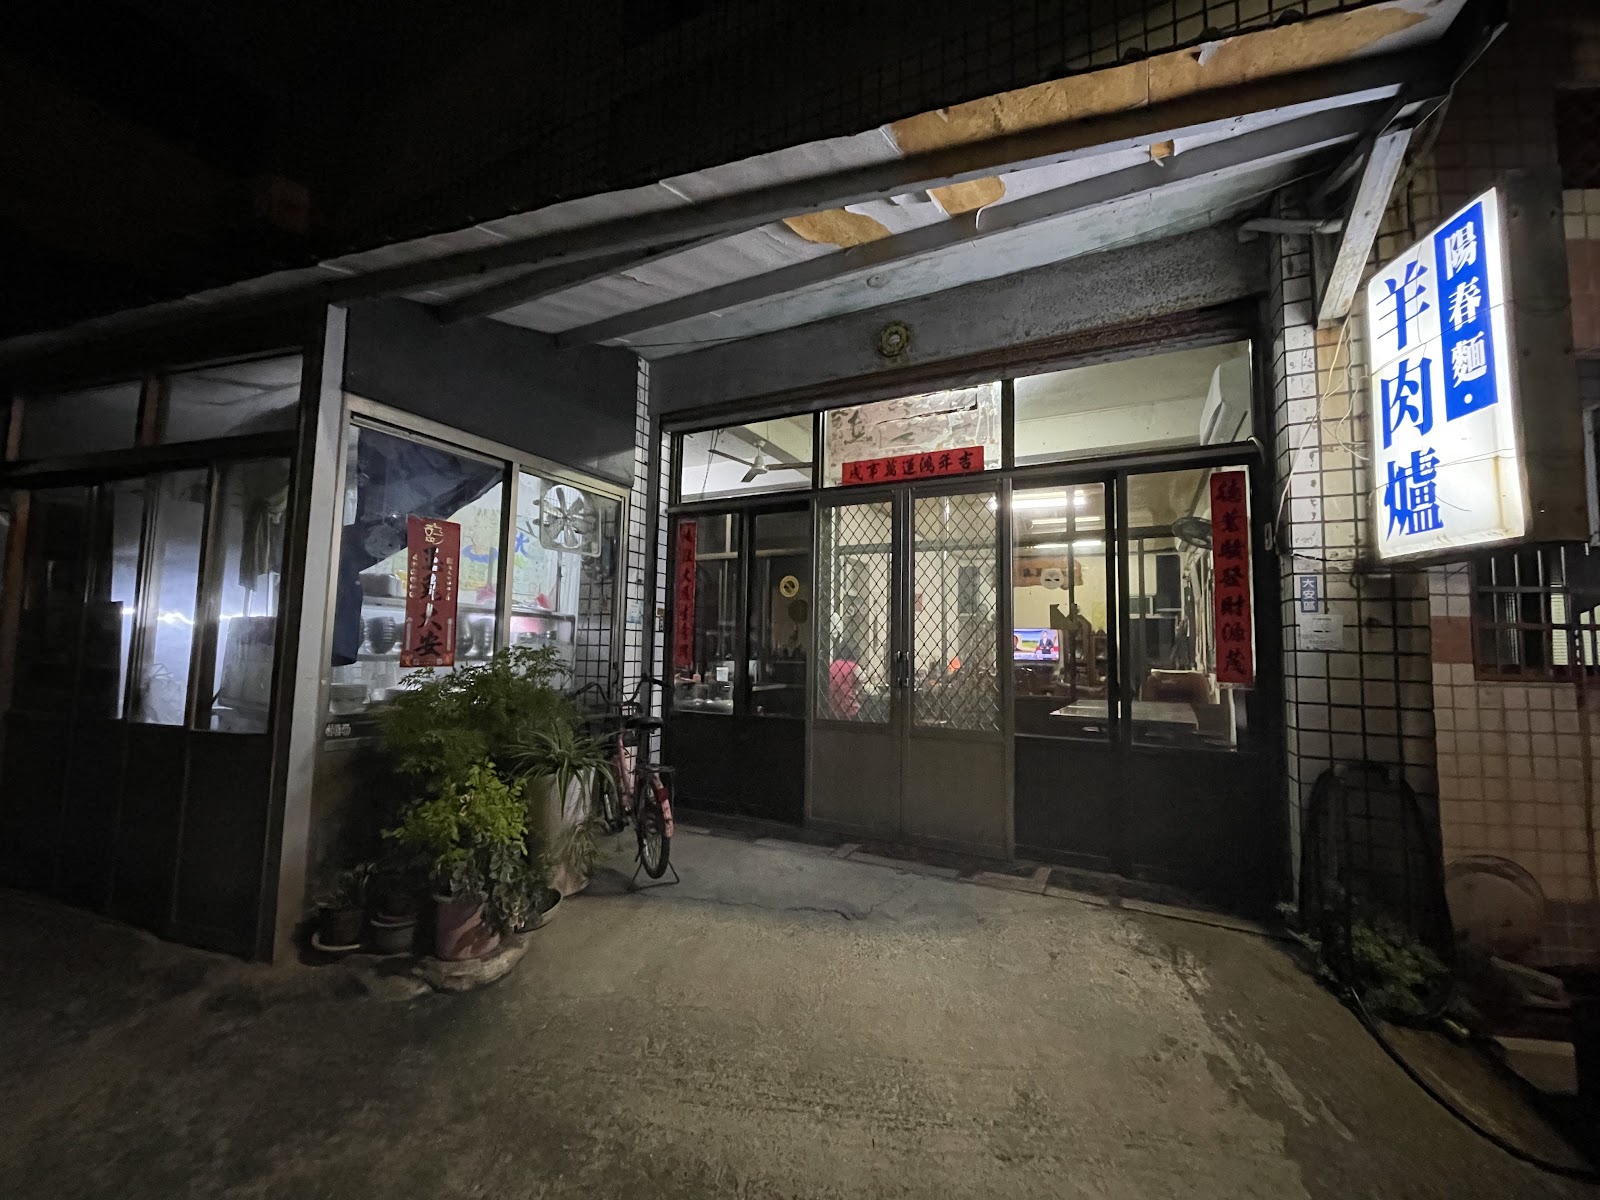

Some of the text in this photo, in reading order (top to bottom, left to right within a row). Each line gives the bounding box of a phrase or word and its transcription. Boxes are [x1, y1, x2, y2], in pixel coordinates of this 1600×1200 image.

[1443, 219, 1488, 391] 陽春麵
[1374, 260, 1445, 542] 羊肉爐
[1302, 578, 1319, 612] 大安區
